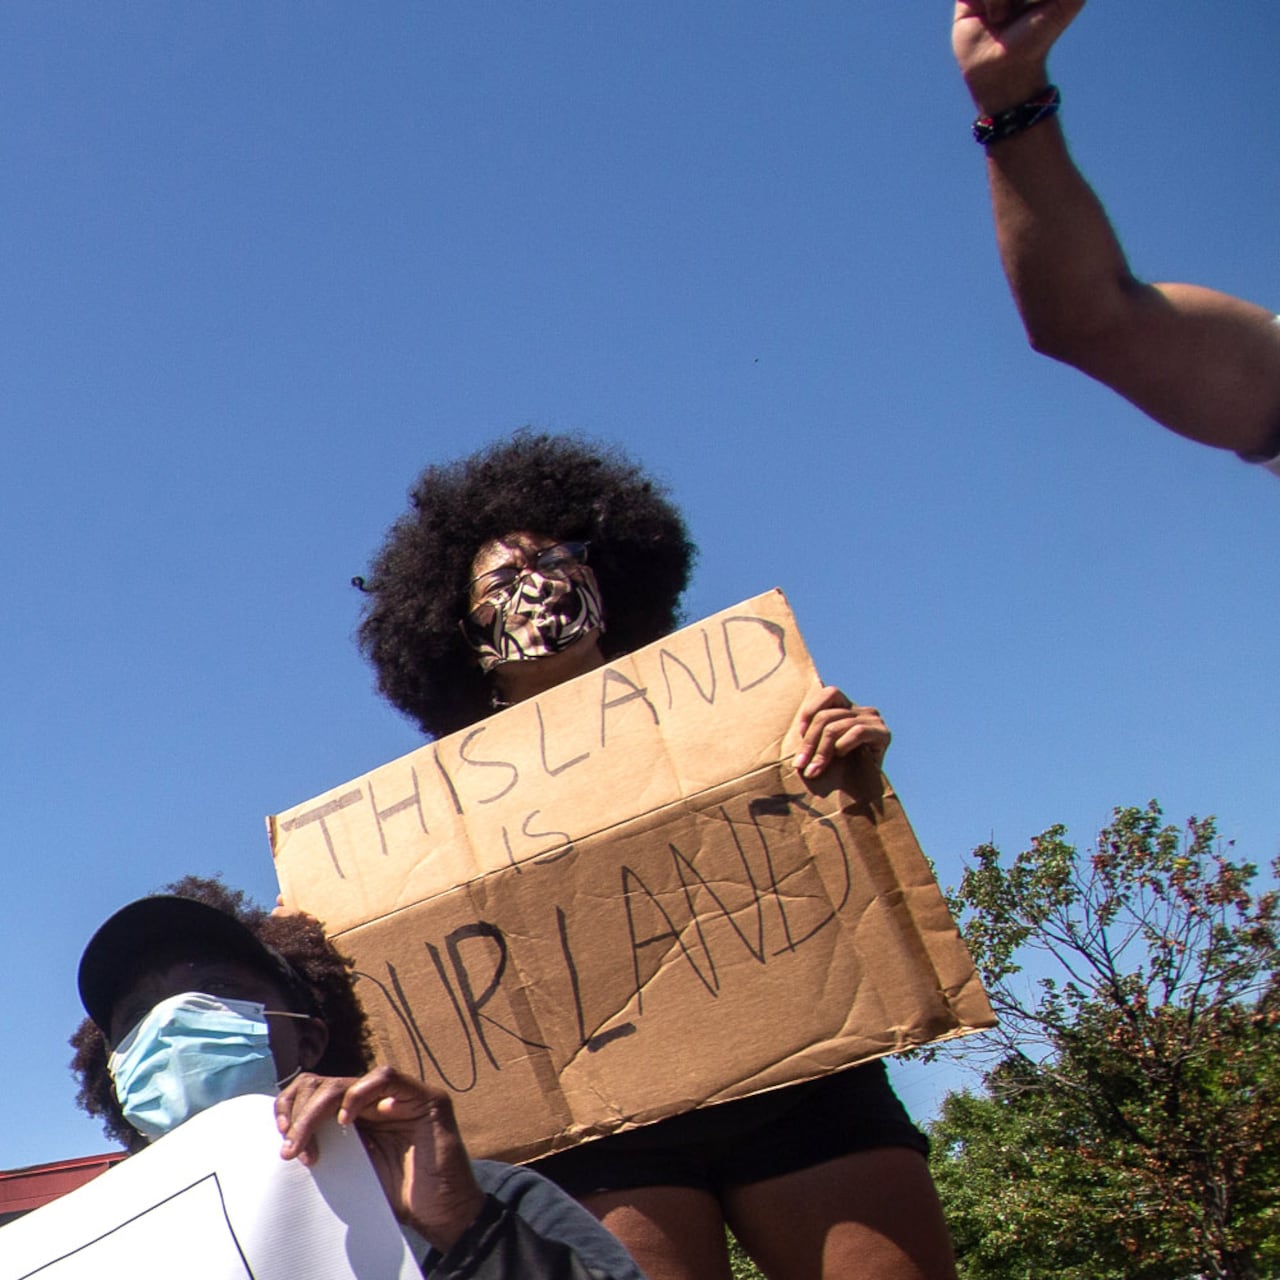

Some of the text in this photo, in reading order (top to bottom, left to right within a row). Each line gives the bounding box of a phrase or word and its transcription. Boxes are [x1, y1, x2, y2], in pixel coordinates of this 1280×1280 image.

[281, 615, 786, 880] THIS LAND
[501, 809, 574, 874] IS
[555, 792, 851, 1053] LAND
